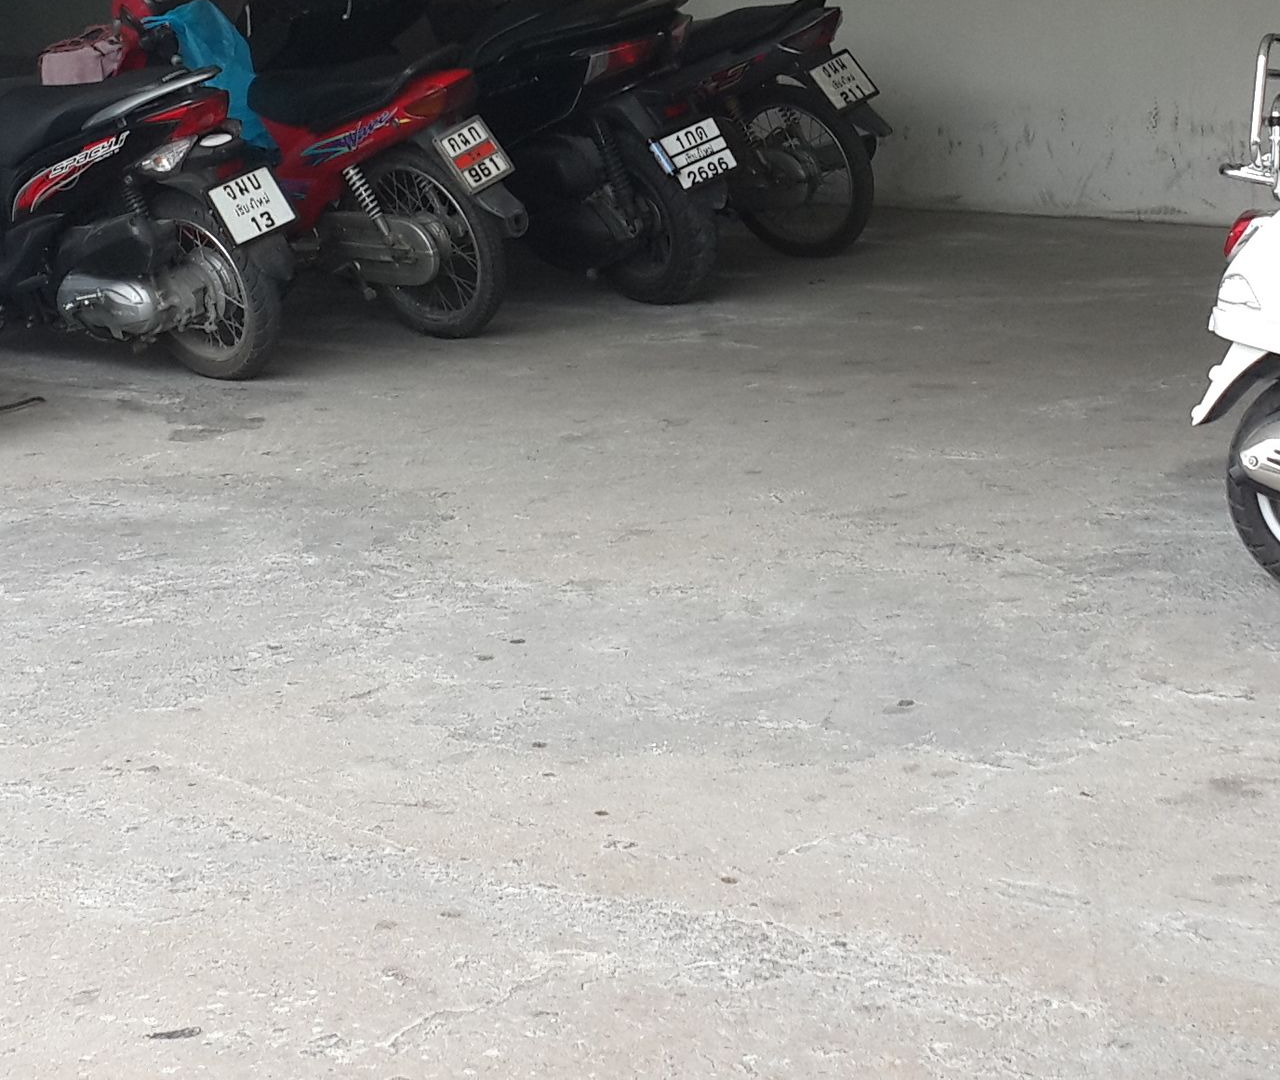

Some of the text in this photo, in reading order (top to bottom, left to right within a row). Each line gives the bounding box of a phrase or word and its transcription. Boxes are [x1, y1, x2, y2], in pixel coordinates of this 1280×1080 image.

[468, 157, 501, 183] 961
[687, 157, 729, 186] 2696
[234, 191, 271, 217] เชียงใหม่
[250, 211, 276, 232] 13
